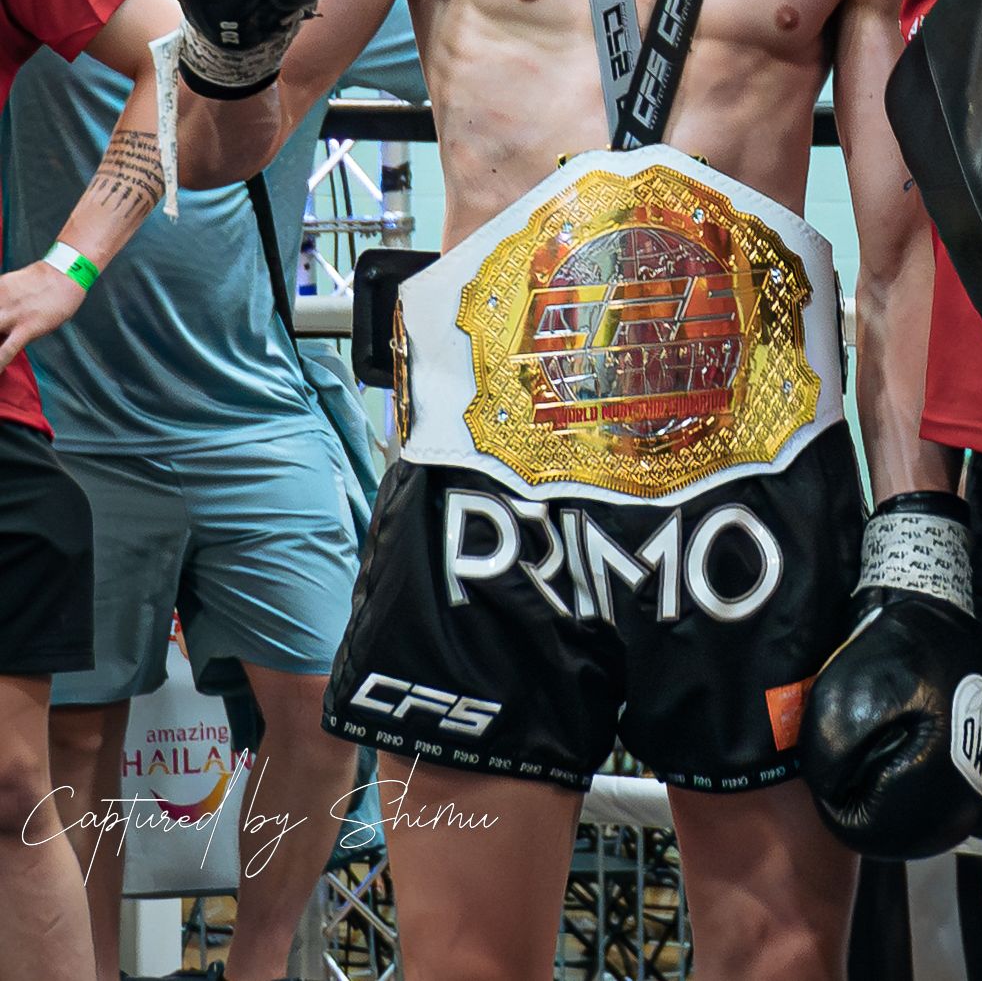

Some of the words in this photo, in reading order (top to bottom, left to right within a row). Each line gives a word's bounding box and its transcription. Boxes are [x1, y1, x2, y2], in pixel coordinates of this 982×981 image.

[632, 48, 670, 130] CFS
[446, 487, 783, 626] PRIMO
[146, 721, 229, 743] amazing
[350, 672, 502, 737] CFS
[122, 746, 253, 777] HAILAN
